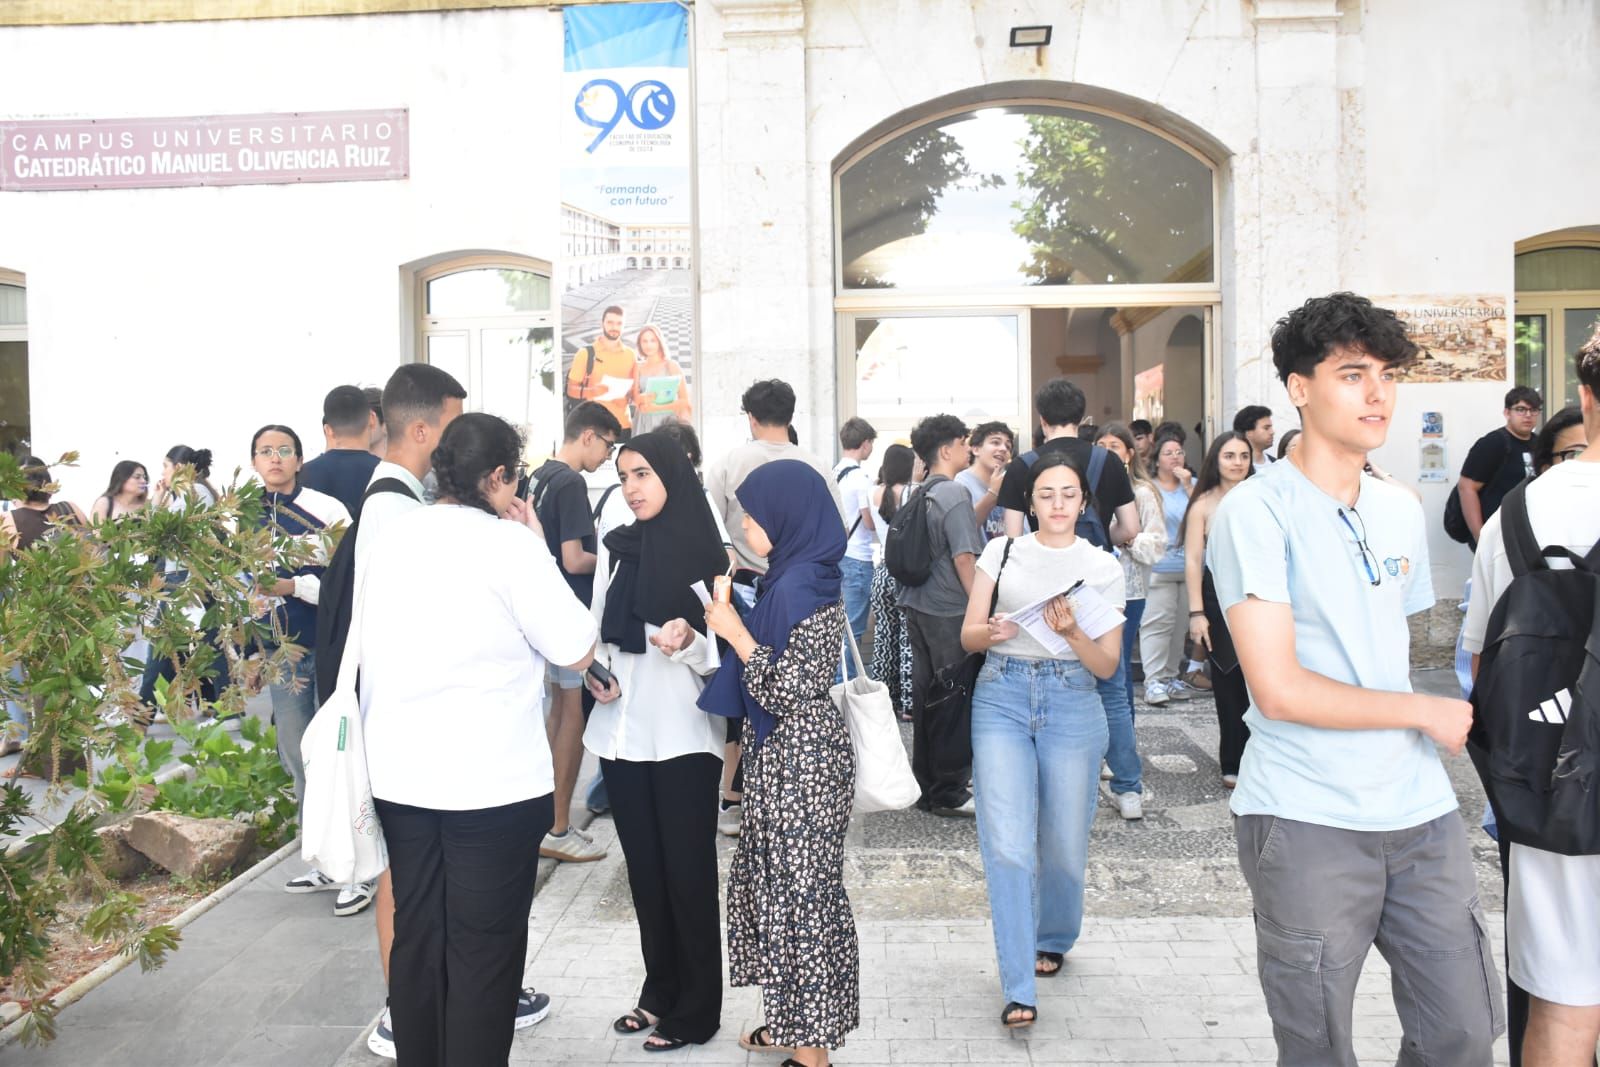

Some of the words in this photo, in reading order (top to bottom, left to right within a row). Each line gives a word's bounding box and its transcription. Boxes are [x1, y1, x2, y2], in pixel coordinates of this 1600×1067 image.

[13, 132, 134, 151] CAMPUS
[153, 122, 392, 147] UNIVERSITARIO
[14, 152, 145, 178] CATEDRÁTICO
[151, 151, 232, 175] MANUEL
[238, 148, 340, 171] OLIVENCIA
[345, 144, 391, 168] RUIZ
[610, 198, 632, 206] con
[1414, 306, 1505, 318] UNIVERSITARIO
[1422, 323, 1461, 334] CEUTA
